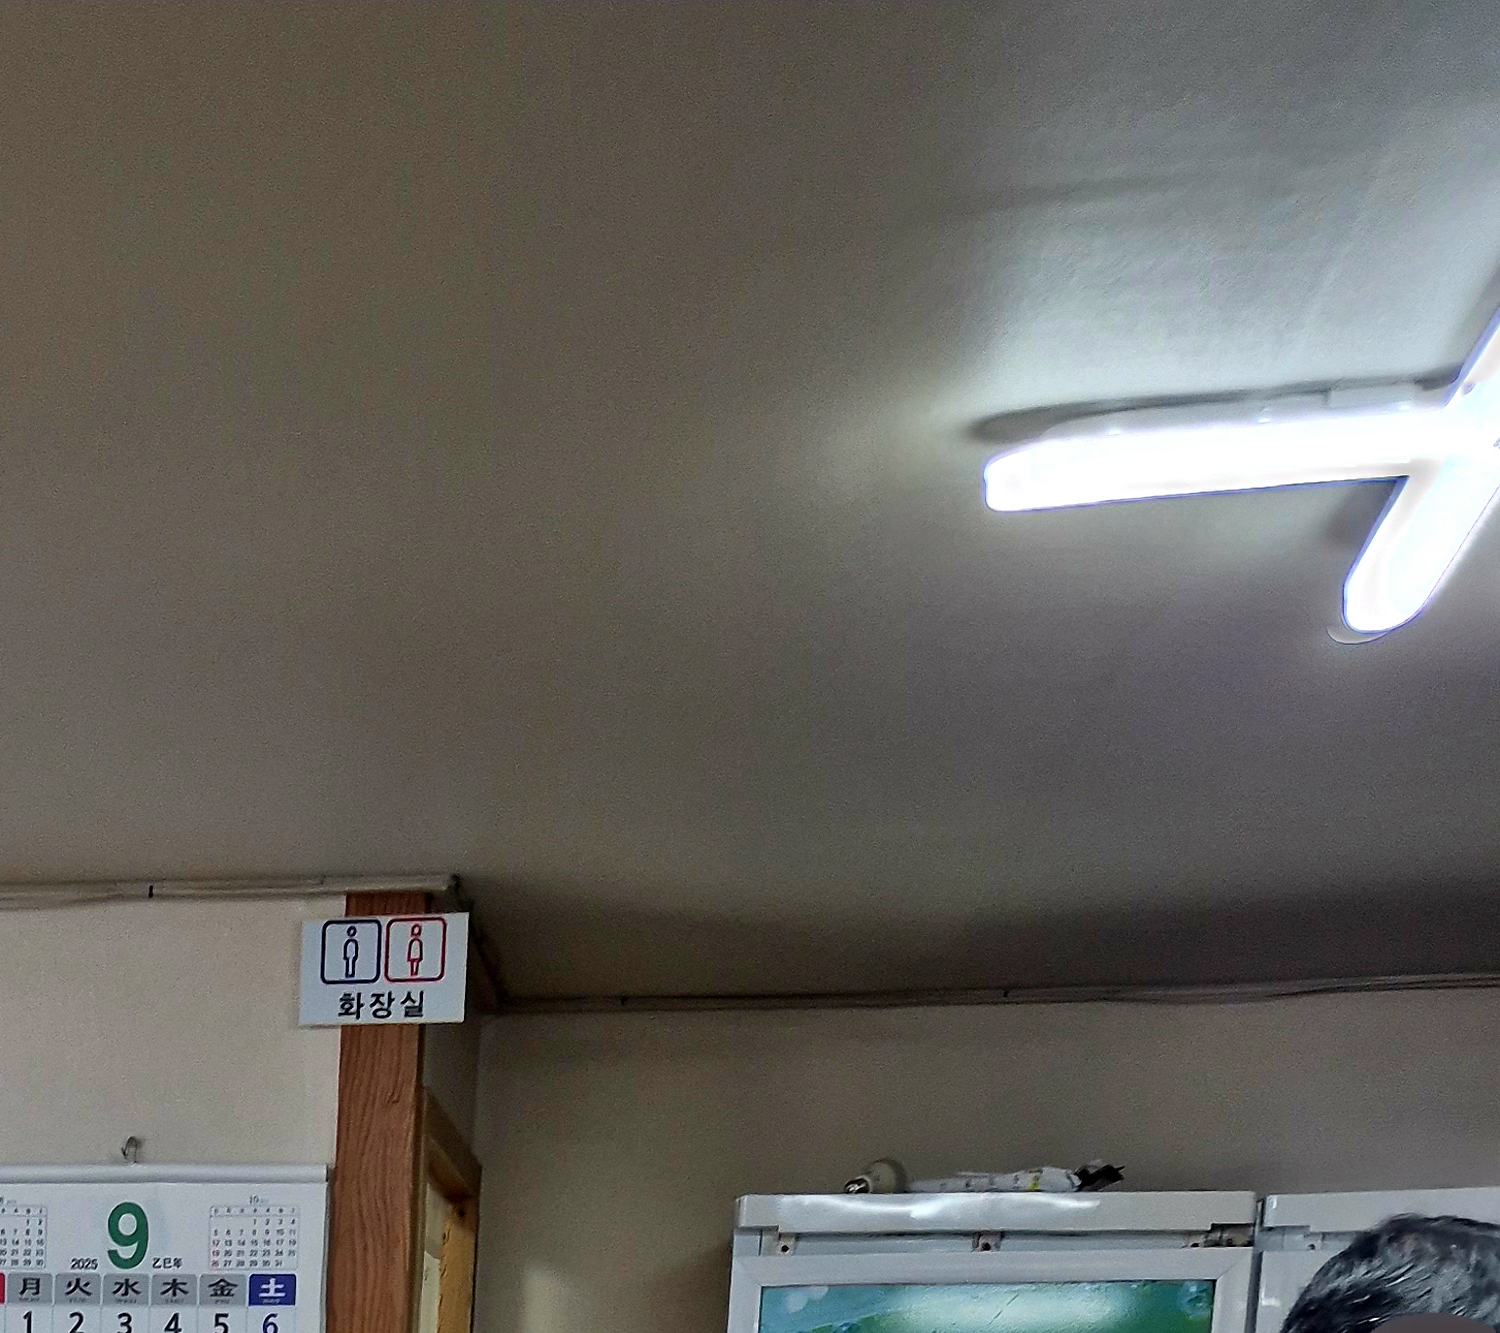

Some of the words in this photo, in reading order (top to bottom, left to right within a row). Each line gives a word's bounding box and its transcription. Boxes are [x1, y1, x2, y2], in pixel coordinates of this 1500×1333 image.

[338, 990, 425, 1020] 화장실
[107, 1201, 150, 1269] 9
[70, 1258, 99, 1270] 2025
[19, 1278, 41, 1296] 月
[66, 1279, 92, 1297] 火
[113, 1279, 141, 1297] 水
[160, 1279, 189, 1297] 木
[208, 1278, 238, 1298] 金
[259, 1279, 287, 1298] 土
